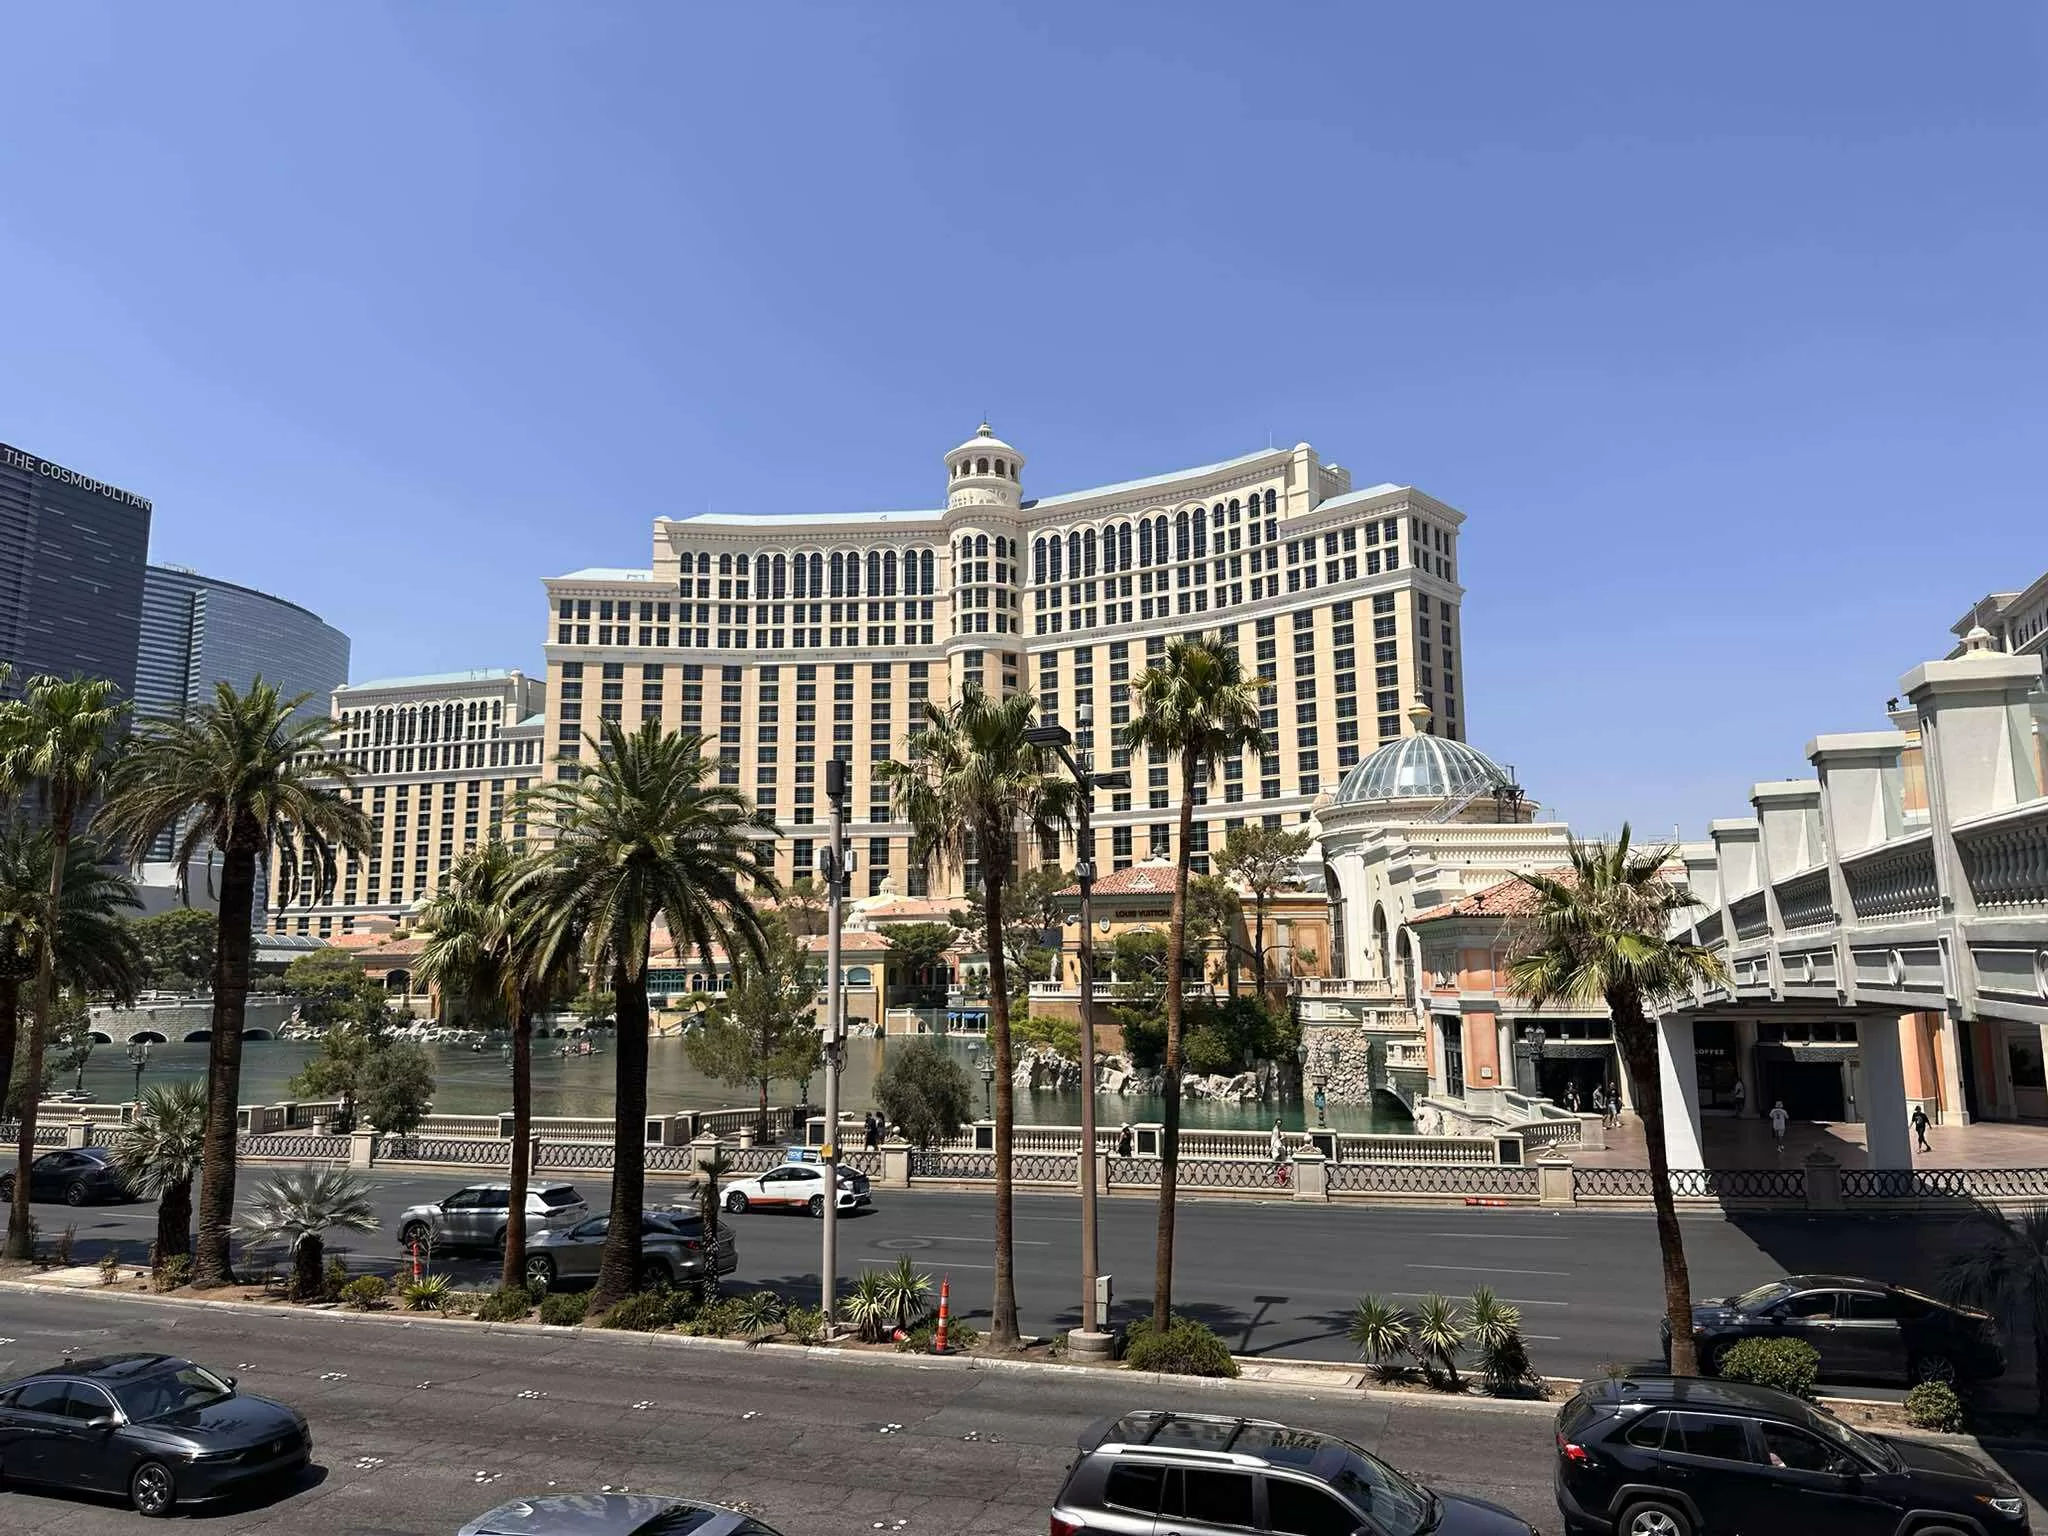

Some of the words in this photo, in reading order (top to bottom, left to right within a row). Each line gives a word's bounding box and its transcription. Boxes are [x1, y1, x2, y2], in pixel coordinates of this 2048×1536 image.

[4, 448, 35, 471] THE
[40, 462, 152, 511] COSMOPOLITAN
[1138, 909, 1170, 917] VUITTON
